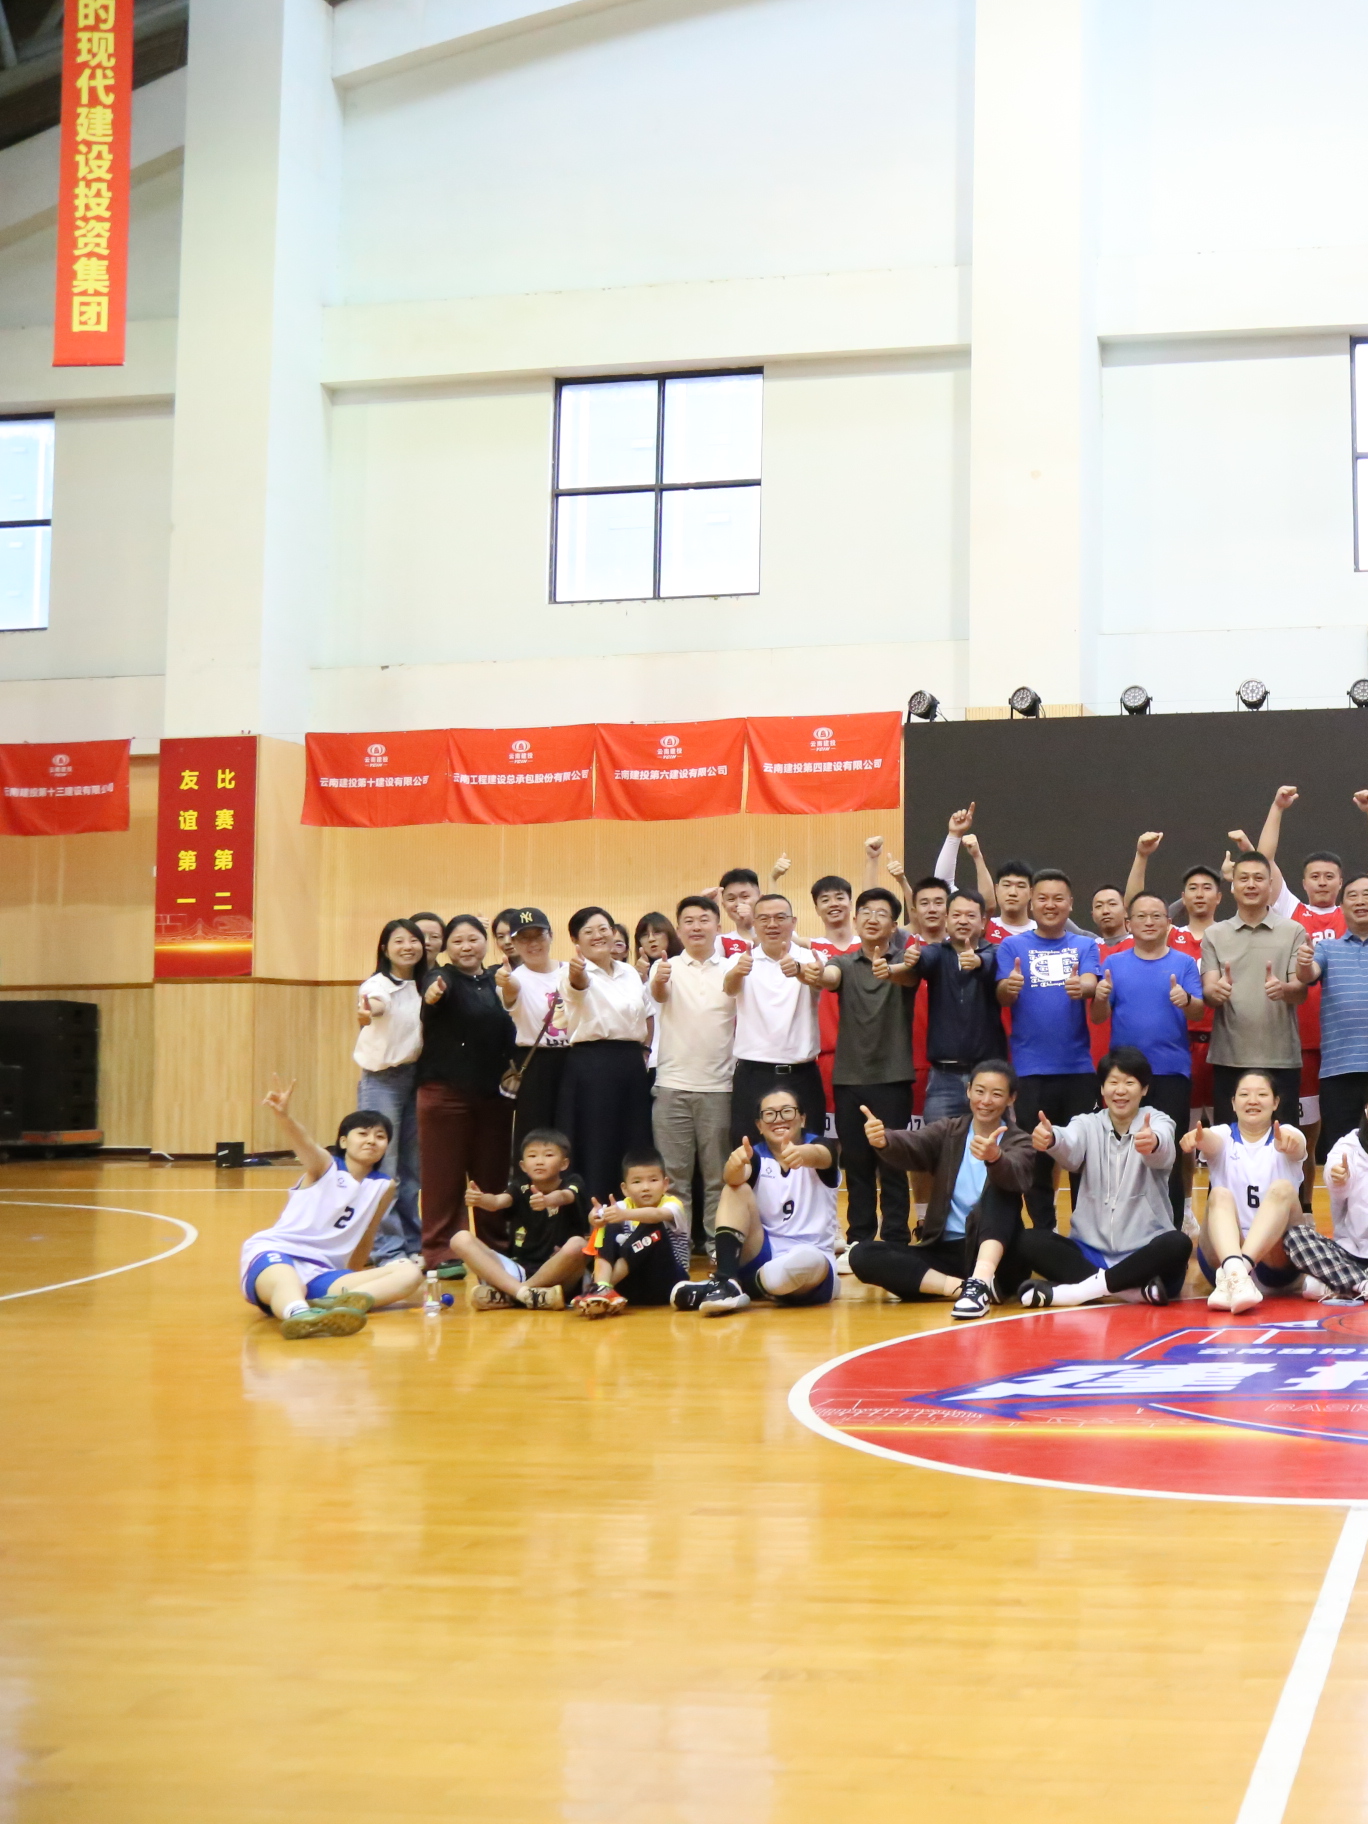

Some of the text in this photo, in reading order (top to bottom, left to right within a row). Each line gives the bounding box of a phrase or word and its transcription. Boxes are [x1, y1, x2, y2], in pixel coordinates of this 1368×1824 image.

[72, 0, 115, 332] 的现代建设投资集团
[453, 769, 590, 785] 云南工程建设总承包股份有限公司
[614, 765, 728, 780] 云南建投第六建设有限公司
[763, 758, 883, 774] 云南建投第四建设有限公司
[319, 775, 430, 788] 云南建投第十建设有限公司
[176, 770, 200, 903] 友谊第一
[213, 769, 236, 910] 比赛第二
[1247, 1184, 1260, 1208] 6
[333, 1206, 355, 1229] 2
[782, 1199, 795, 1222] 9
[266, 1252, 282, 1263] 2
